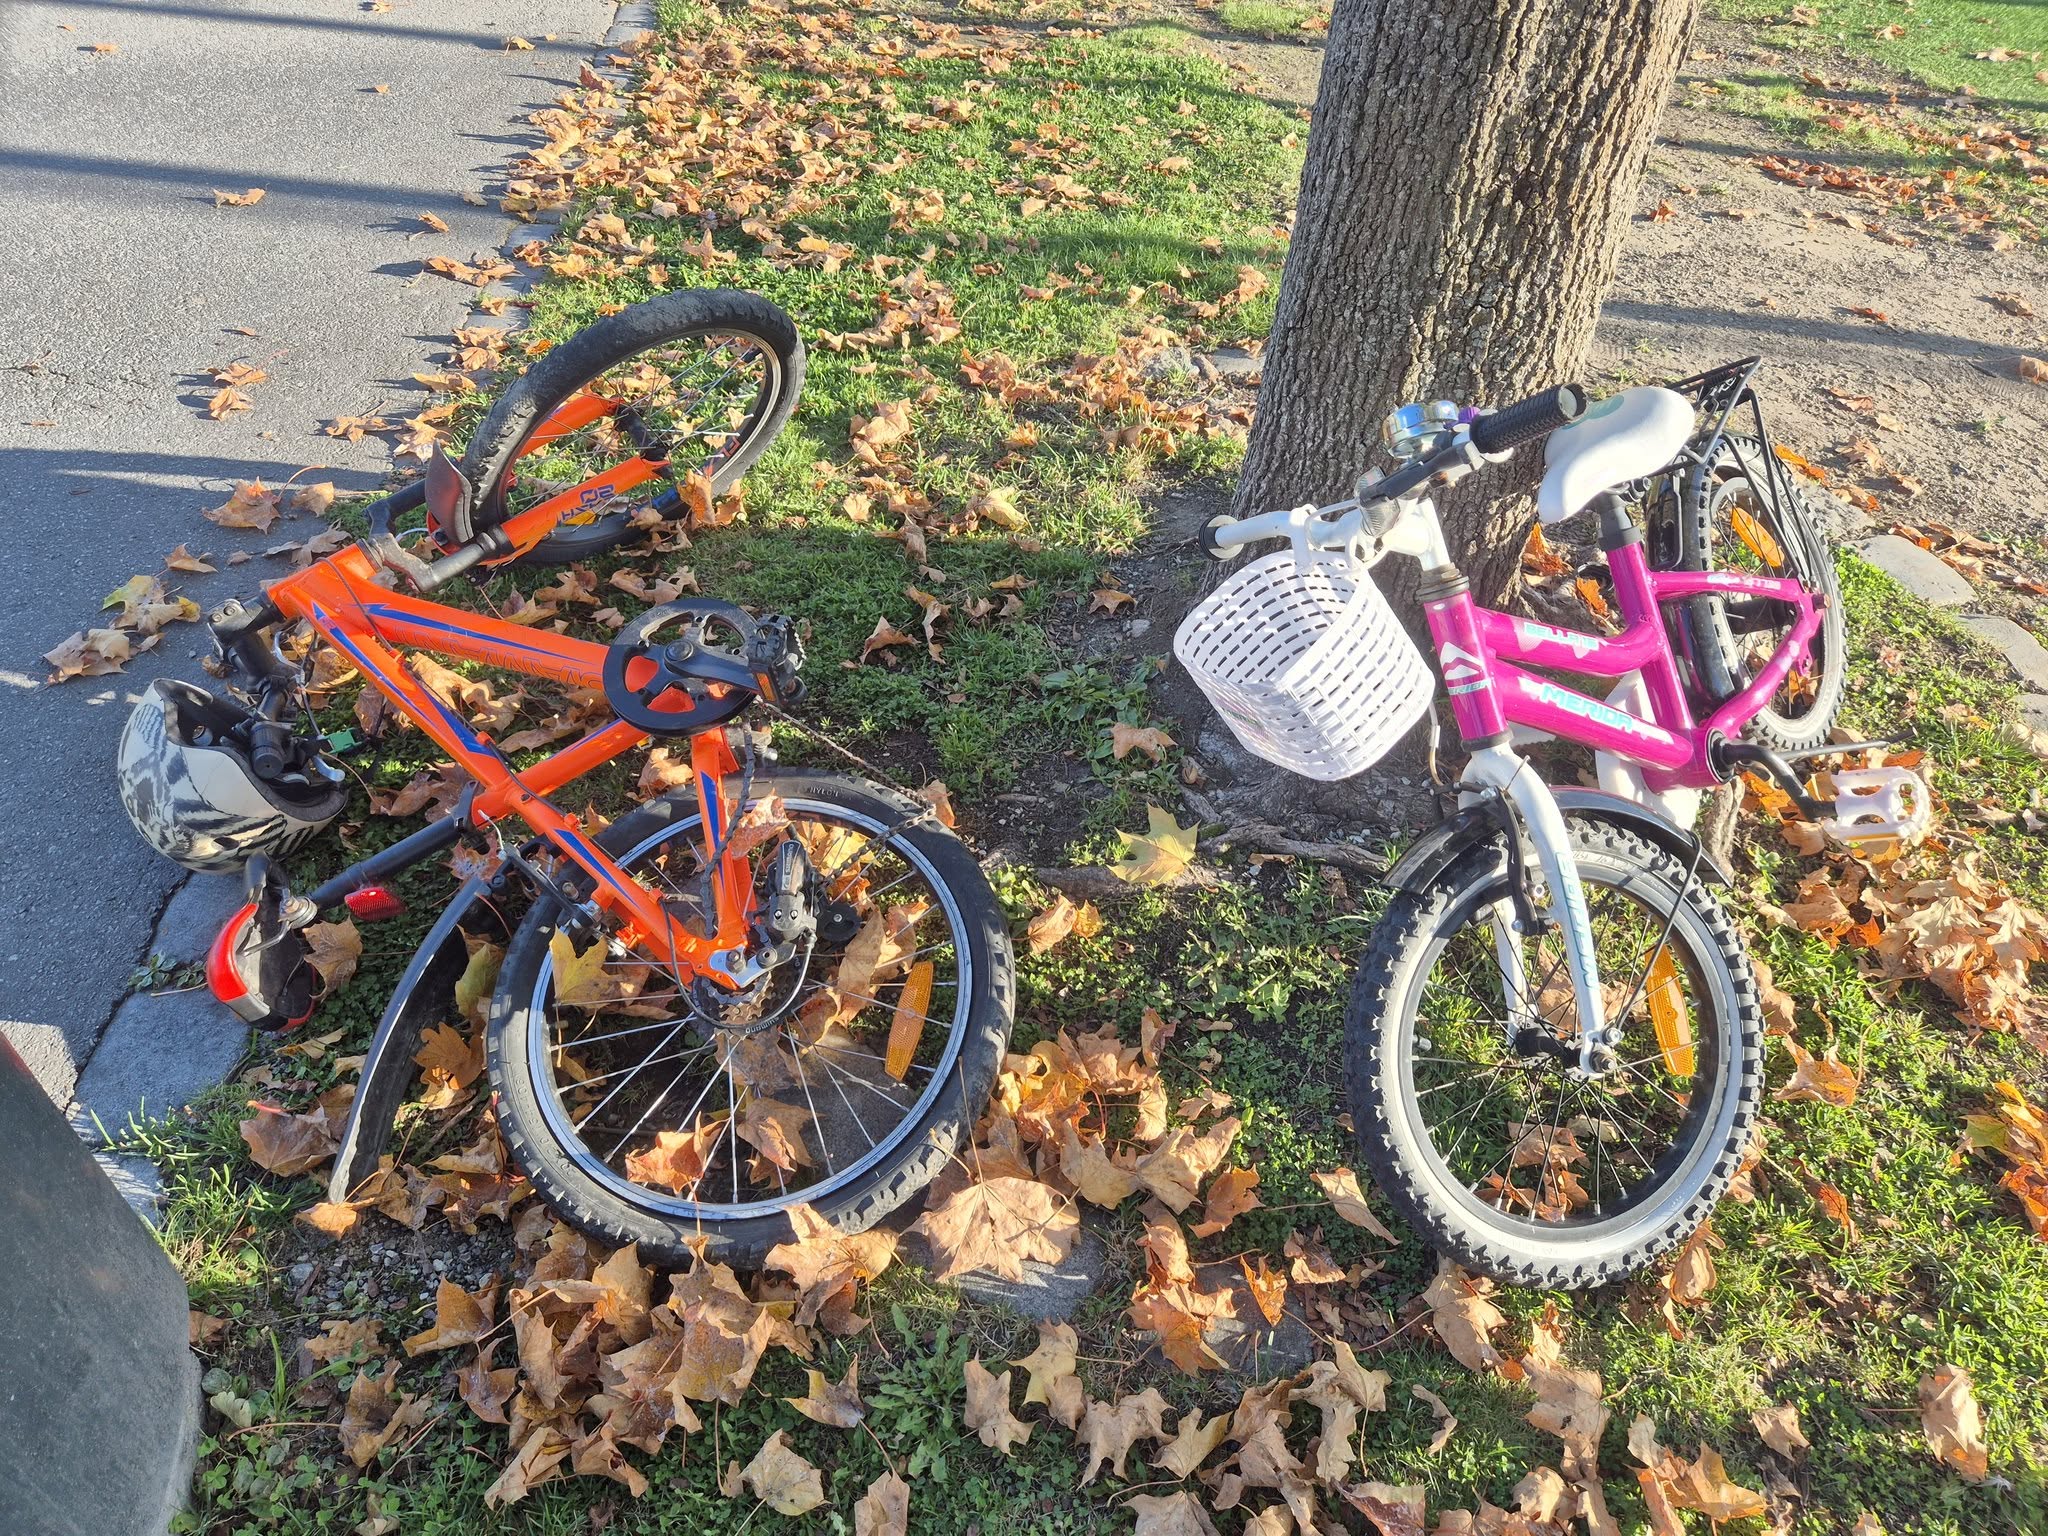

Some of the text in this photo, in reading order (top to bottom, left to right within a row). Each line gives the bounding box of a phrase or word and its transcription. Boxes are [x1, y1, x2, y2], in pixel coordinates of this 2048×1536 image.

[1524, 622, 1580, 645] BELLA
[1448, 679, 1491, 696] ERIDA
[1540, 684, 1632, 731] MERIDA
